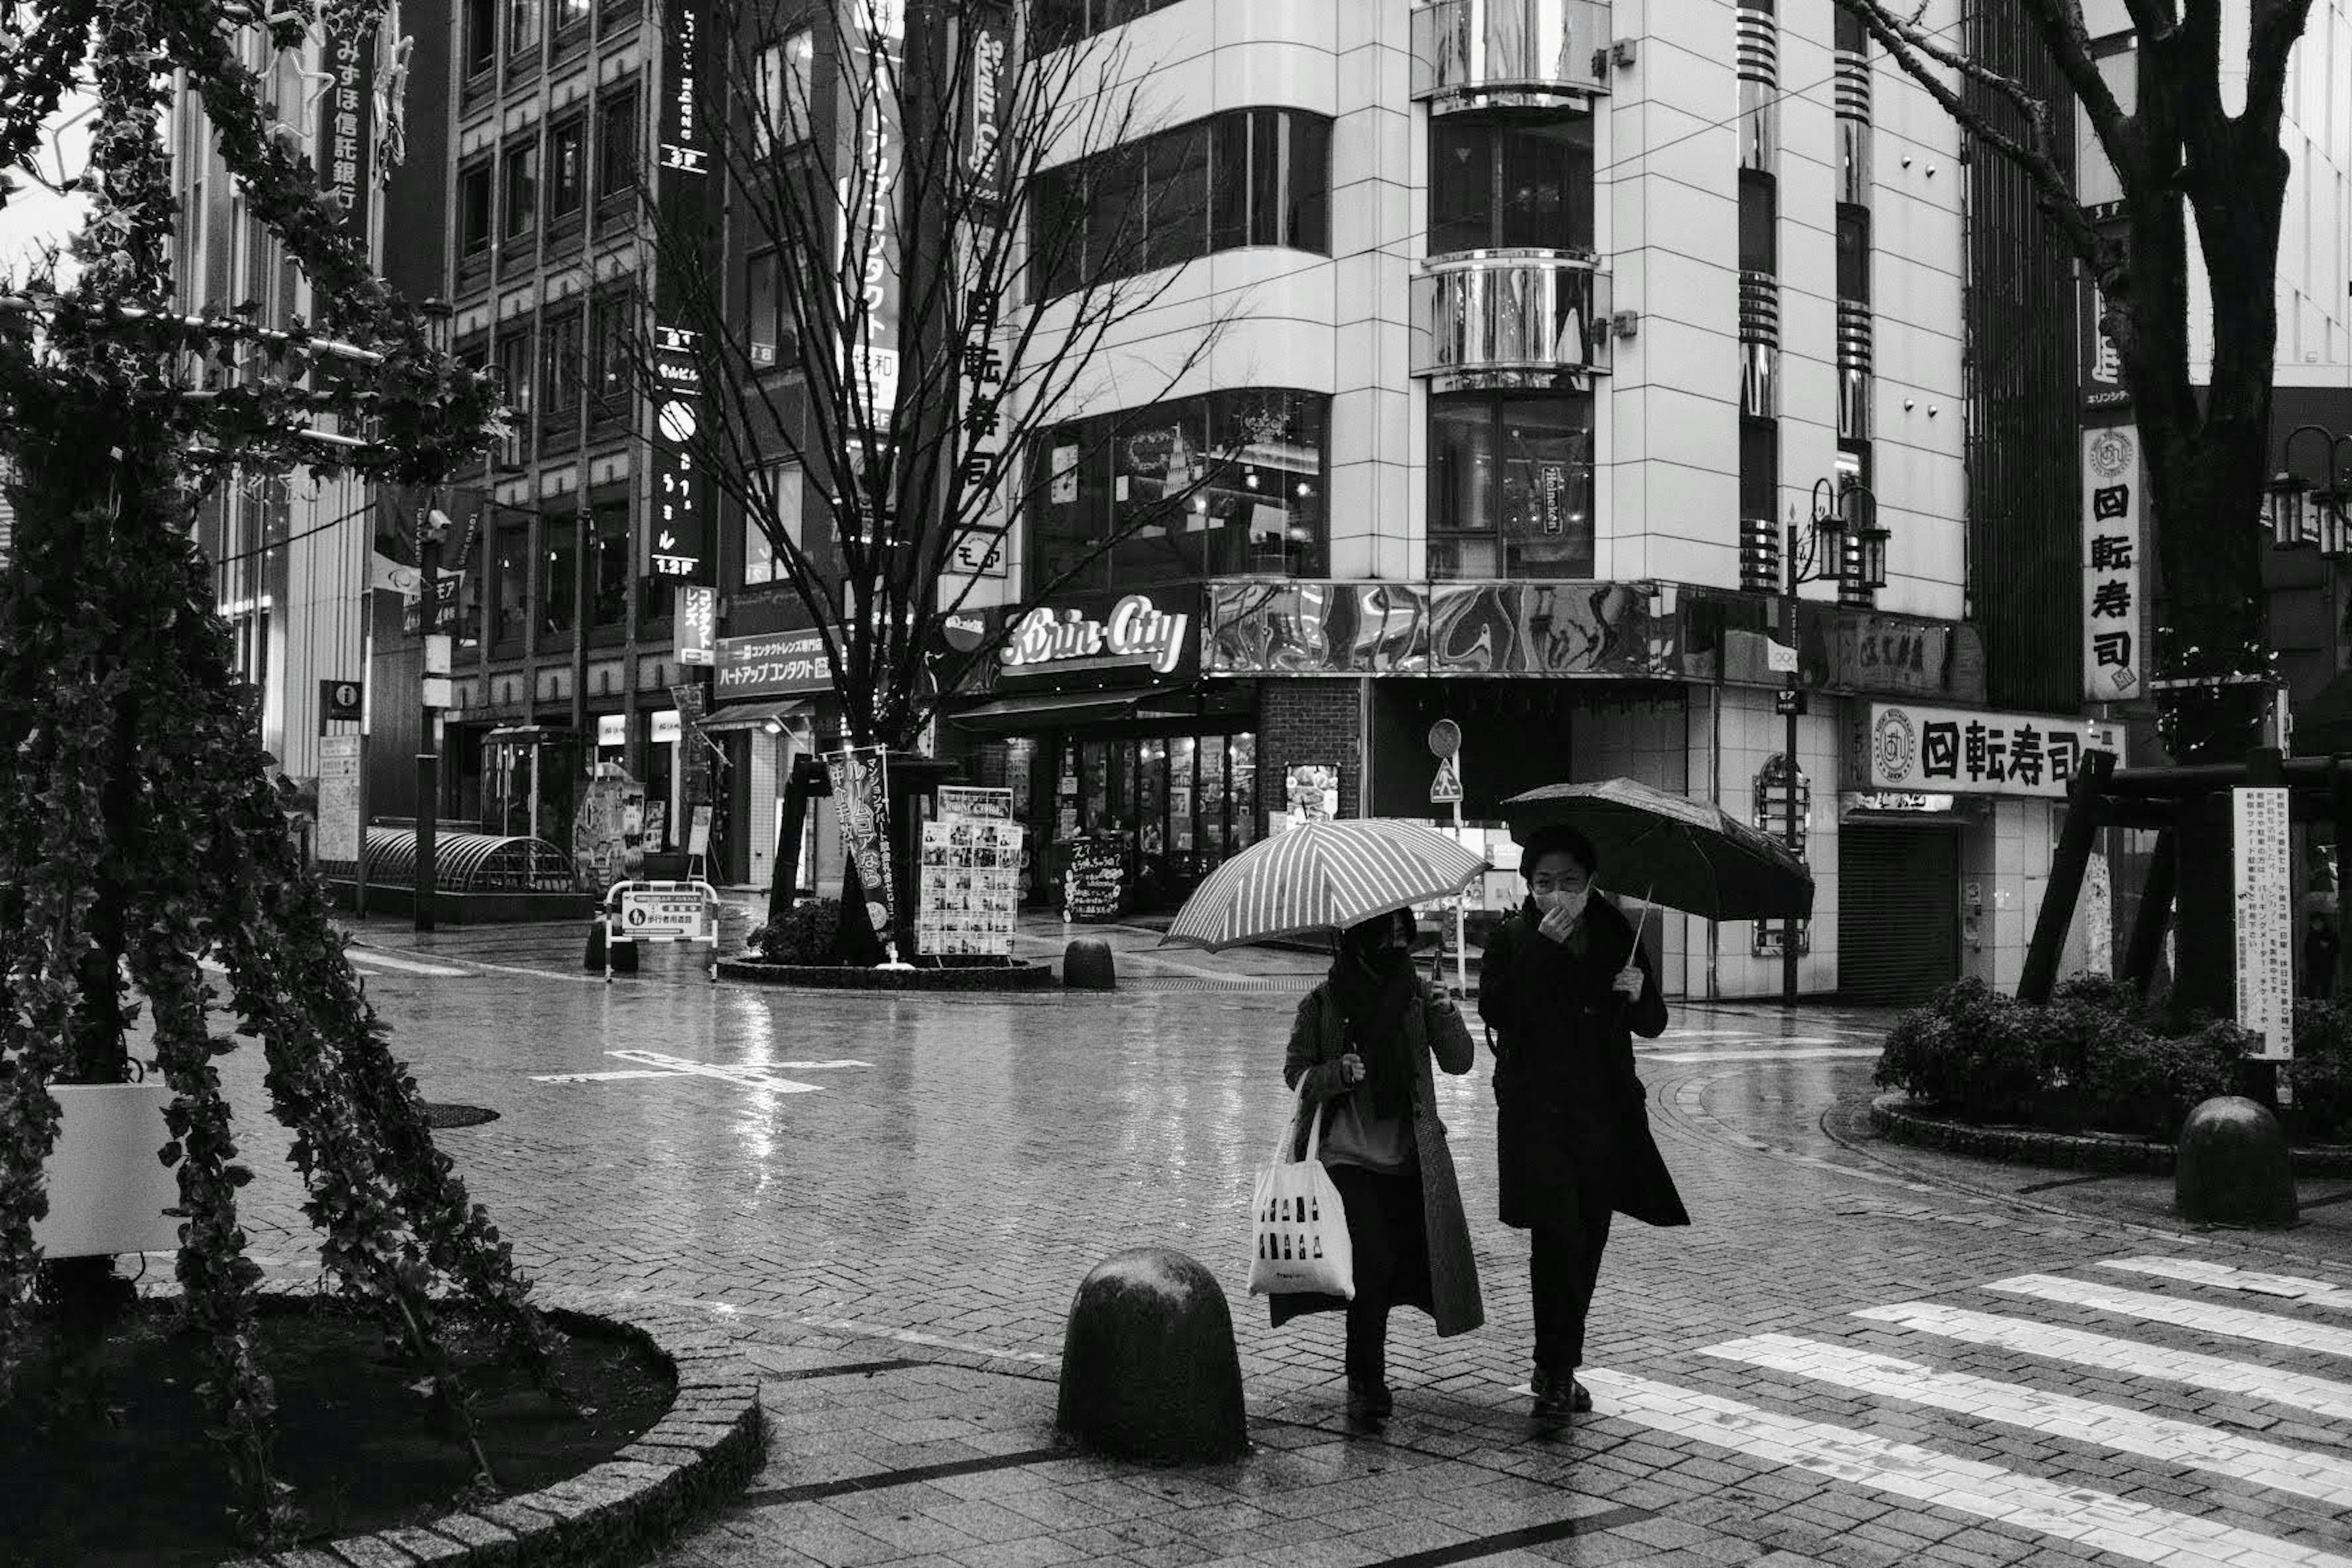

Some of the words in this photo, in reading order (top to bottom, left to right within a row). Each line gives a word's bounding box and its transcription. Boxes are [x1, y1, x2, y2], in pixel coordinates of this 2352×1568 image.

[334, 39, 360, 209] みずほ信託銀行
[679, 77, 693, 140] azabu
[1546, 472, 1558, 530] Heineken
[2090, 483, 2133, 668] 回転寿司
[685, 588, 698, 627] レンズ
[699, 589, 712, 649] コンタクト
[1000, 594, 1188, 673] Kirin-City
[751, 638, 823, 658] コンタクトレンズ専門店
[1921, 719, 2081, 786] 回転寿司
